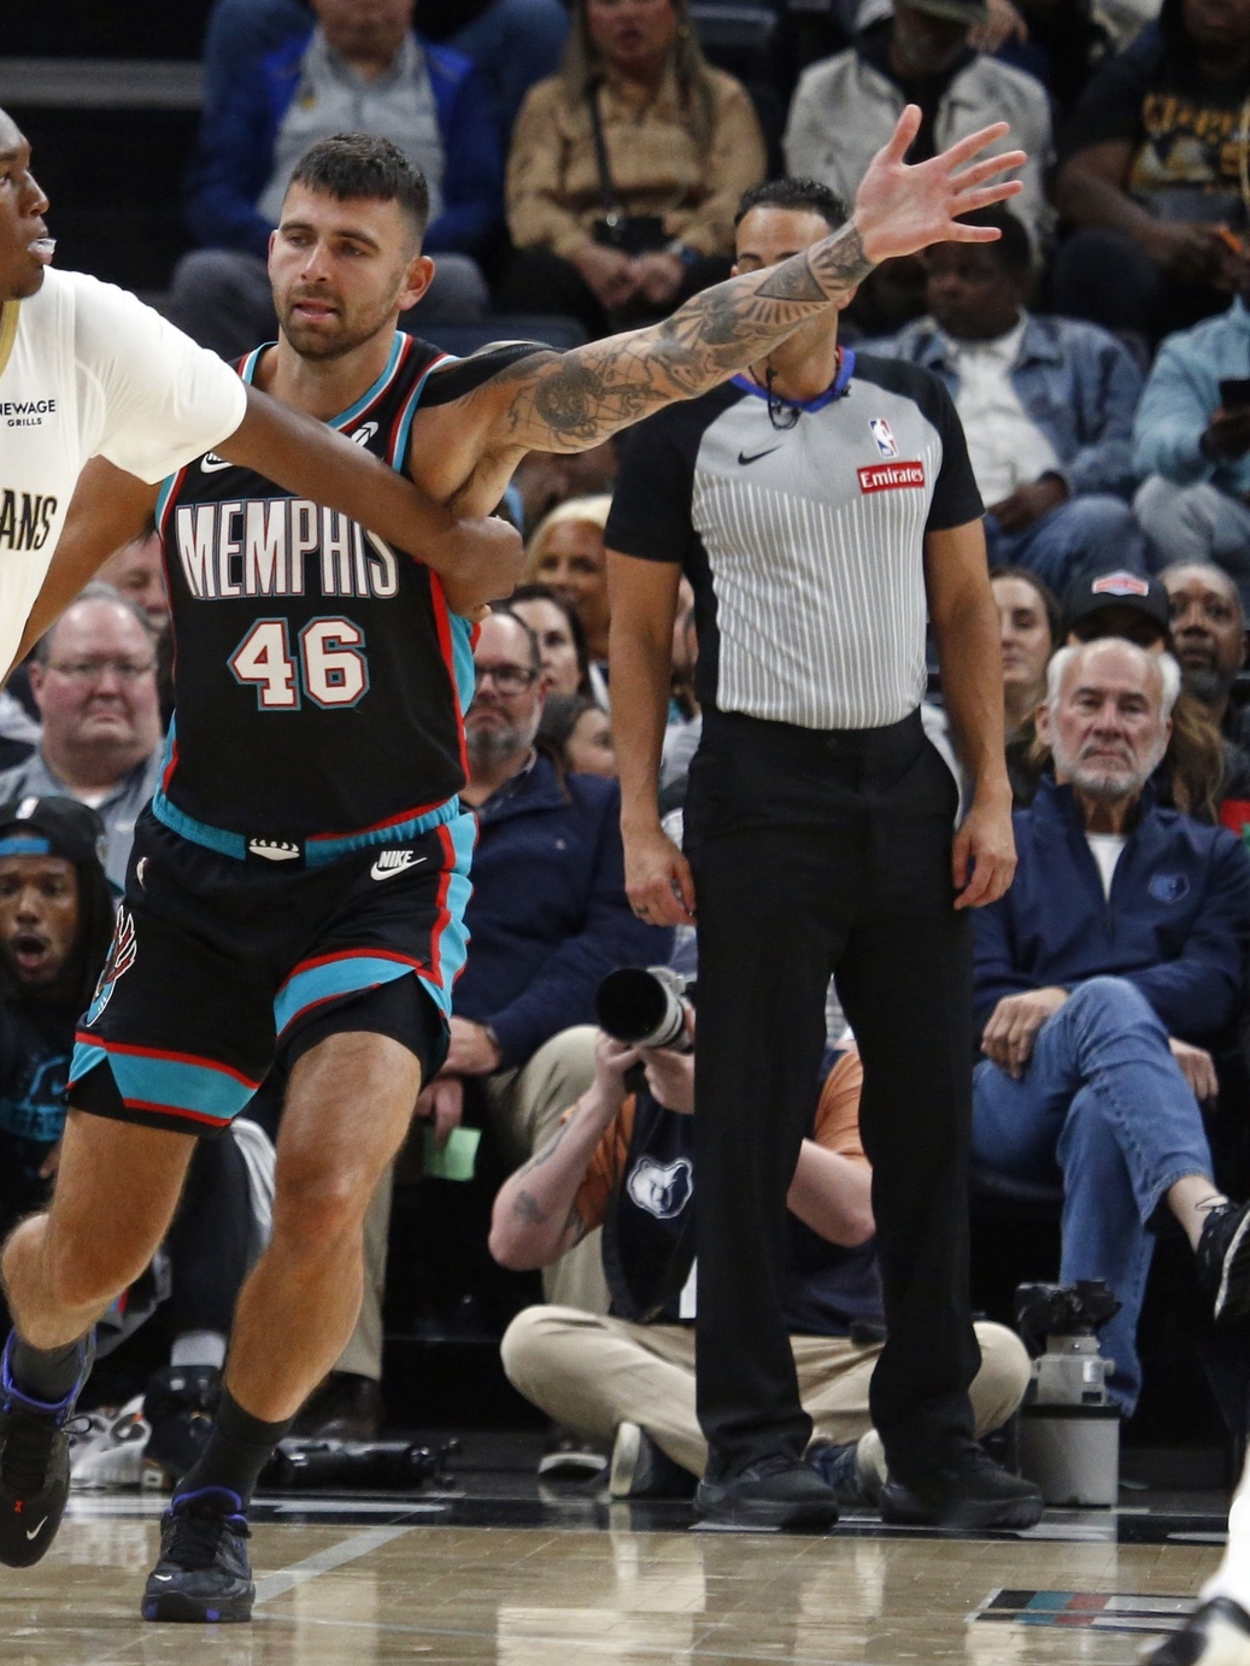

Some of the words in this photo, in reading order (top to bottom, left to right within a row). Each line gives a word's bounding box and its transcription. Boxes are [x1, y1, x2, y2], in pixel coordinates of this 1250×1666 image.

[7, 417, 42, 427] GRILLS
[860, 467, 923, 489] Emirates
[175, 496, 399, 600] MEMPHIS
[226, 616, 370, 711] 46
[377, 850, 414, 868] NIKE
